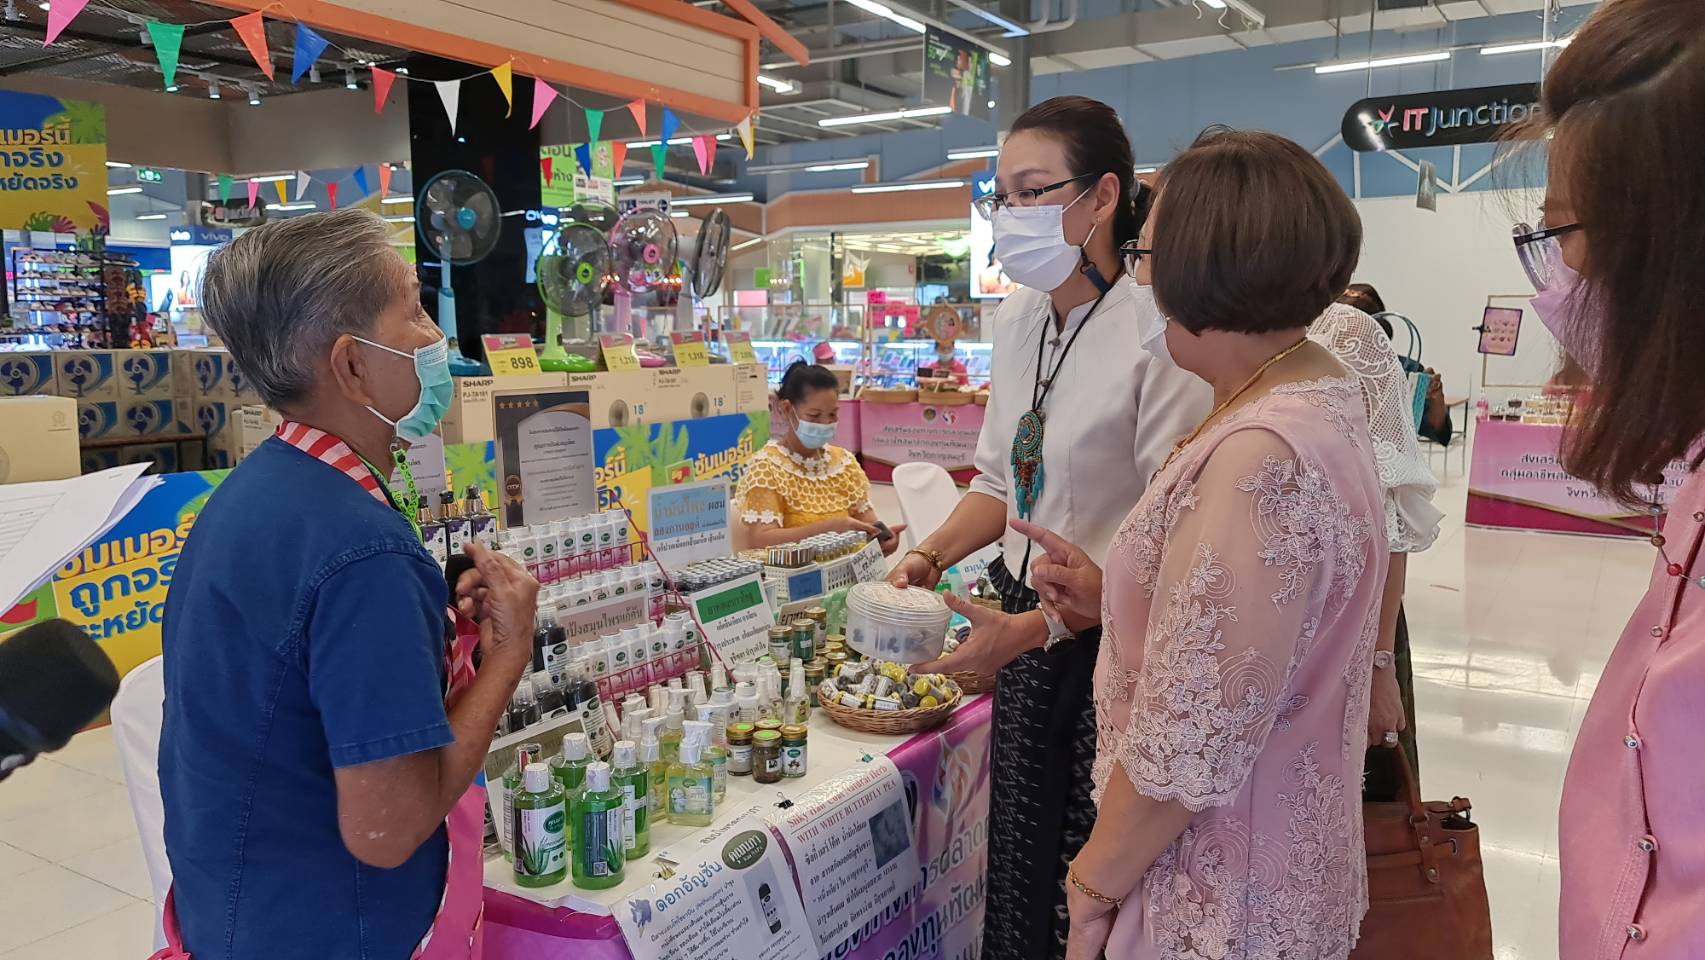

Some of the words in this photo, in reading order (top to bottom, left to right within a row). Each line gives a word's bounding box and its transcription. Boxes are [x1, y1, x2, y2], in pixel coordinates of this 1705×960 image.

[201, 232, 229, 241] vivo
[510, 357, 534, 369] 898
[463, 380, 494, 388] SHARP
[796, 826, 819, 845] WITH
[819, 811, 845, 830] WHITE
[844, 788, 882, 817] BUTTERFLY
[883, 780, 897, 793] PEA
[655, 861, 723, 912] ดอกอัญชัน
